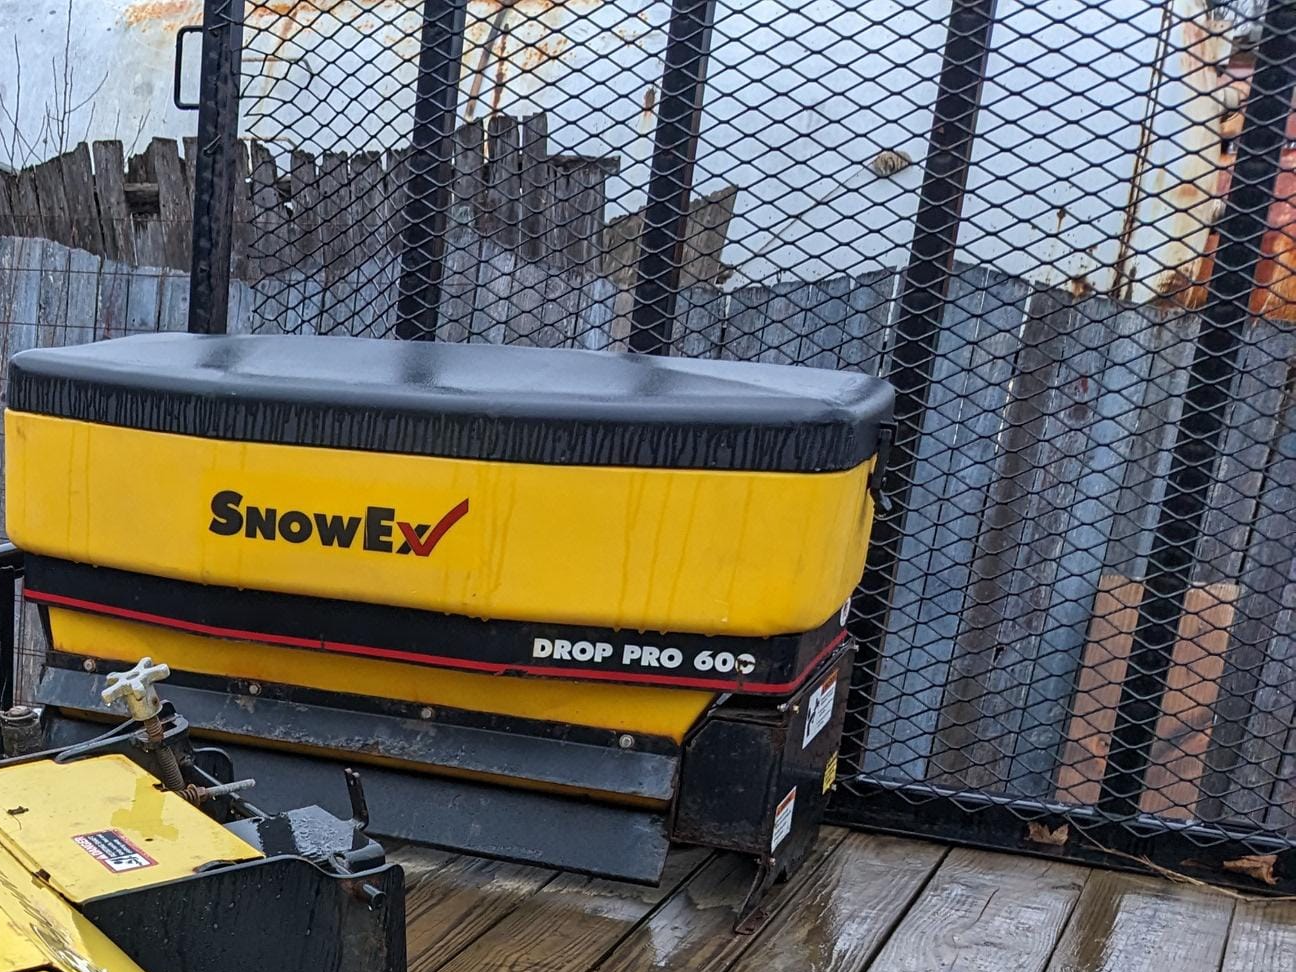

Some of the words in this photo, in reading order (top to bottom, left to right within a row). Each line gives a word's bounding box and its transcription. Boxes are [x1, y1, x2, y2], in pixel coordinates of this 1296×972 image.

[532, 638, 613, 662] DROP
[622, 644, 683, 668] PRO
[693, 650, 756, 674] 600
